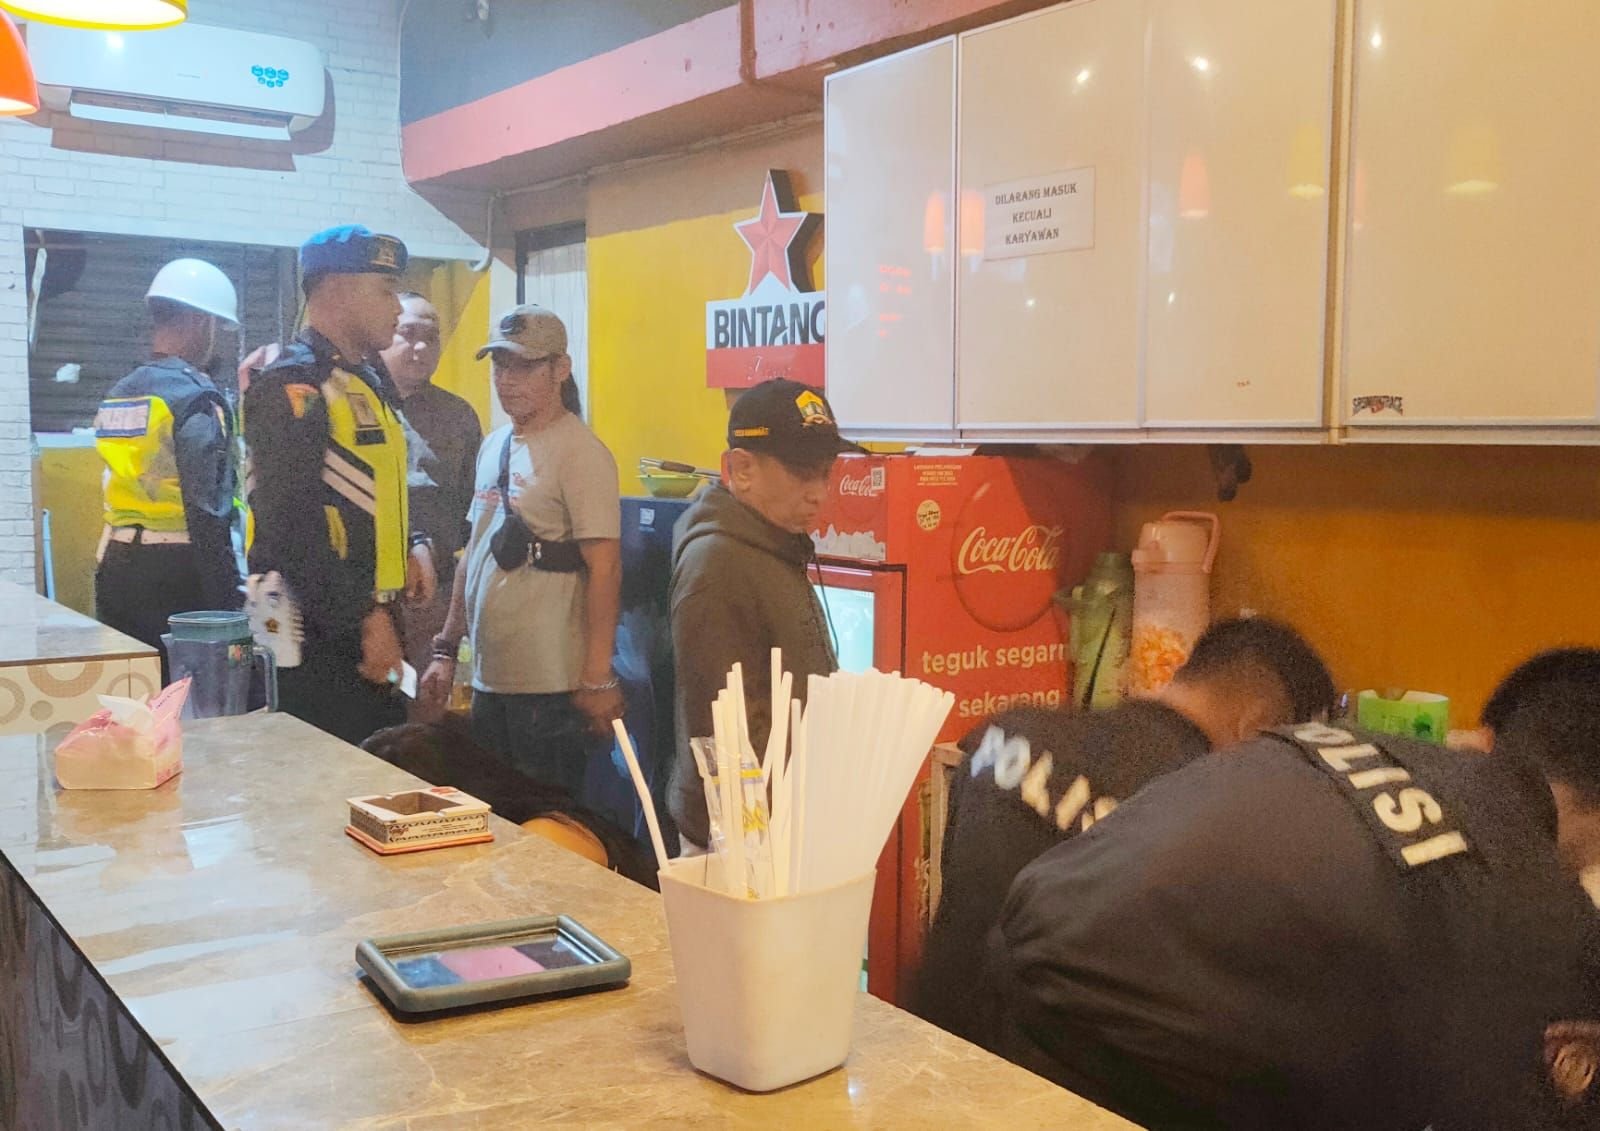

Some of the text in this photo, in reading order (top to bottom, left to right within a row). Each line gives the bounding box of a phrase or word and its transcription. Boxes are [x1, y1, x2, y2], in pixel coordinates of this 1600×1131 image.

[995, 183, 1077, 205] DILARANG MASUK
[1013, 208, 1052, 223] KECUALI
[1006, 228, 1059, 245] KARYAWAN
[958, 526, 1063, 574] Coca-Cola
[922, 644, 988, 676] teguk
[1294, 721, 1468, 866] OLISI
